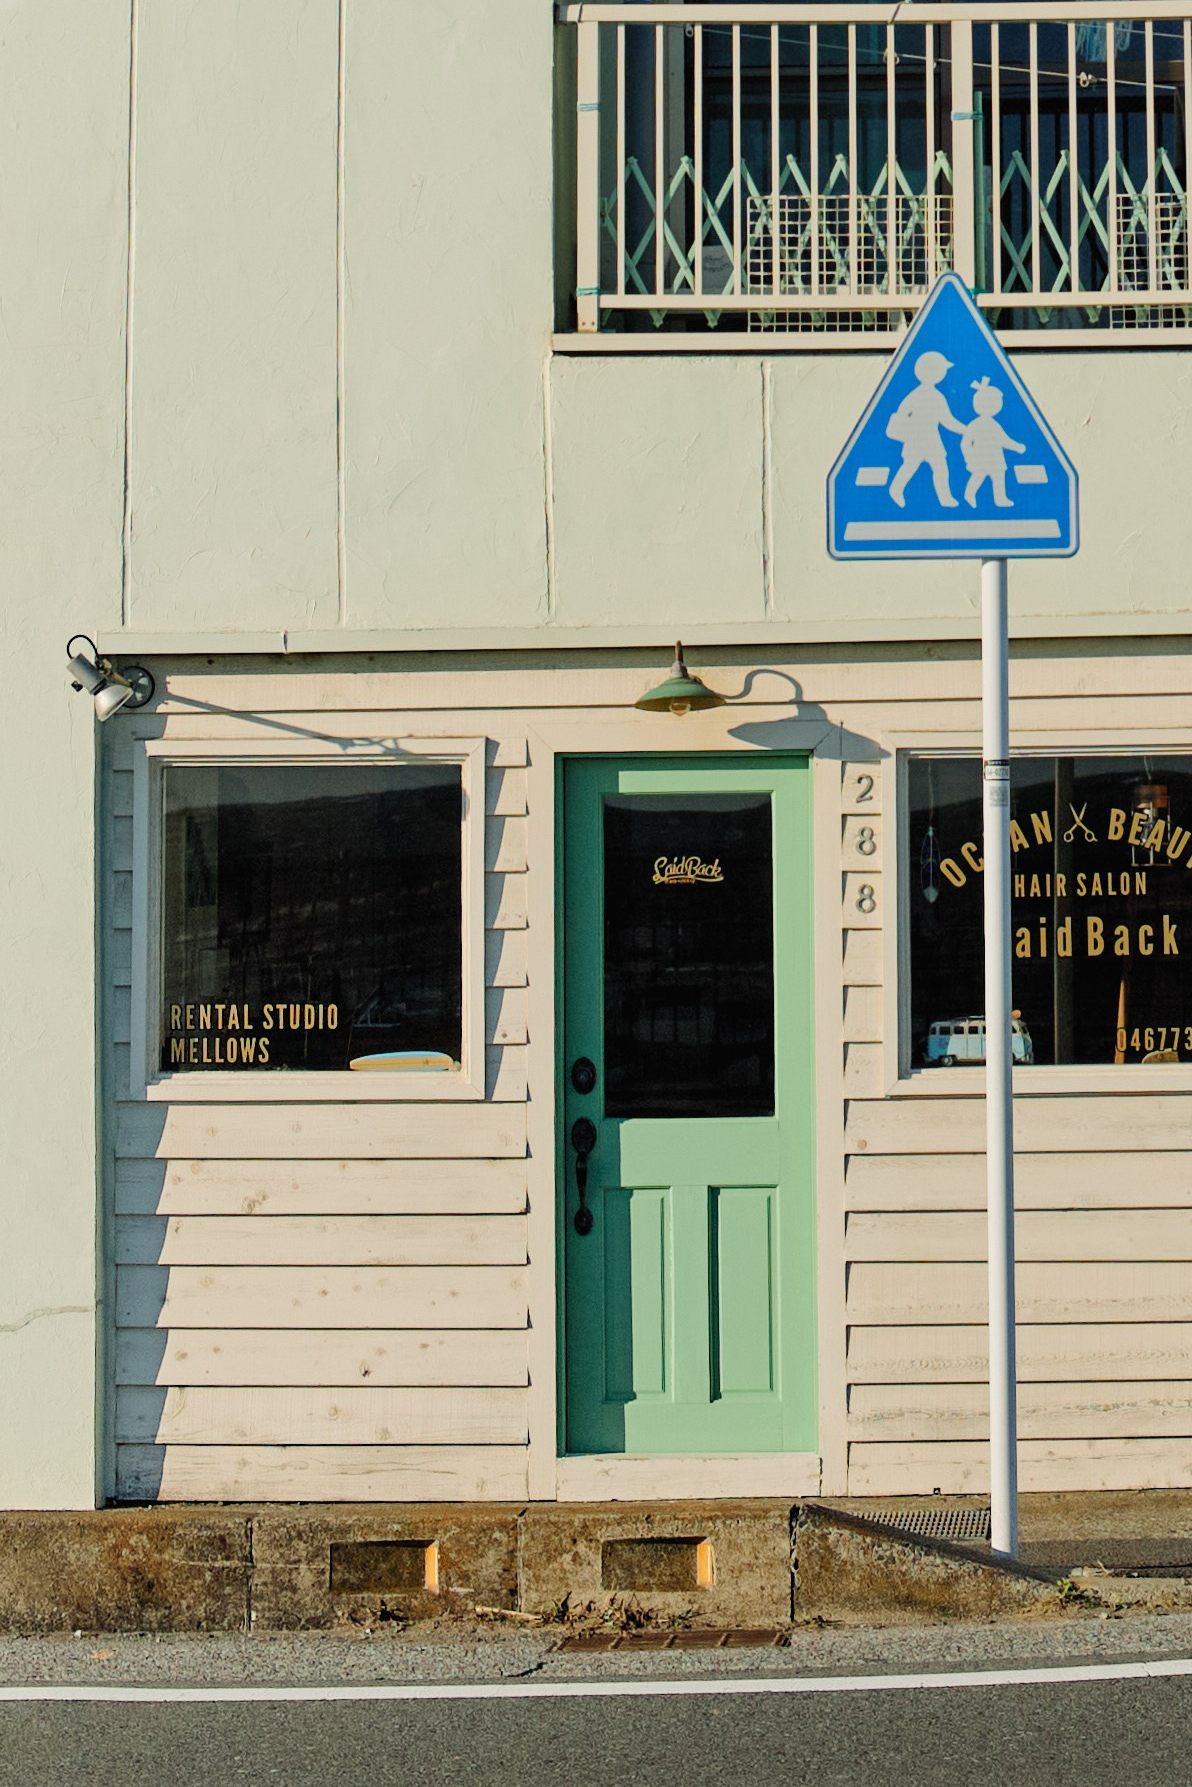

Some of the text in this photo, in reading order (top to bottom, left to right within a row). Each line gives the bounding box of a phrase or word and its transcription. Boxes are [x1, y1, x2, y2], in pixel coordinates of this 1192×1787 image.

[940, 810, 1053, 888] OCAN
[1014, 871, 1147, 898] HAIR SALON
[1015, 914, 1180, 959] aid Back
[170, 1003, 339, 1031] RENTAL STUDIO
[170, 1037, 271, 1064] MELLOWS
